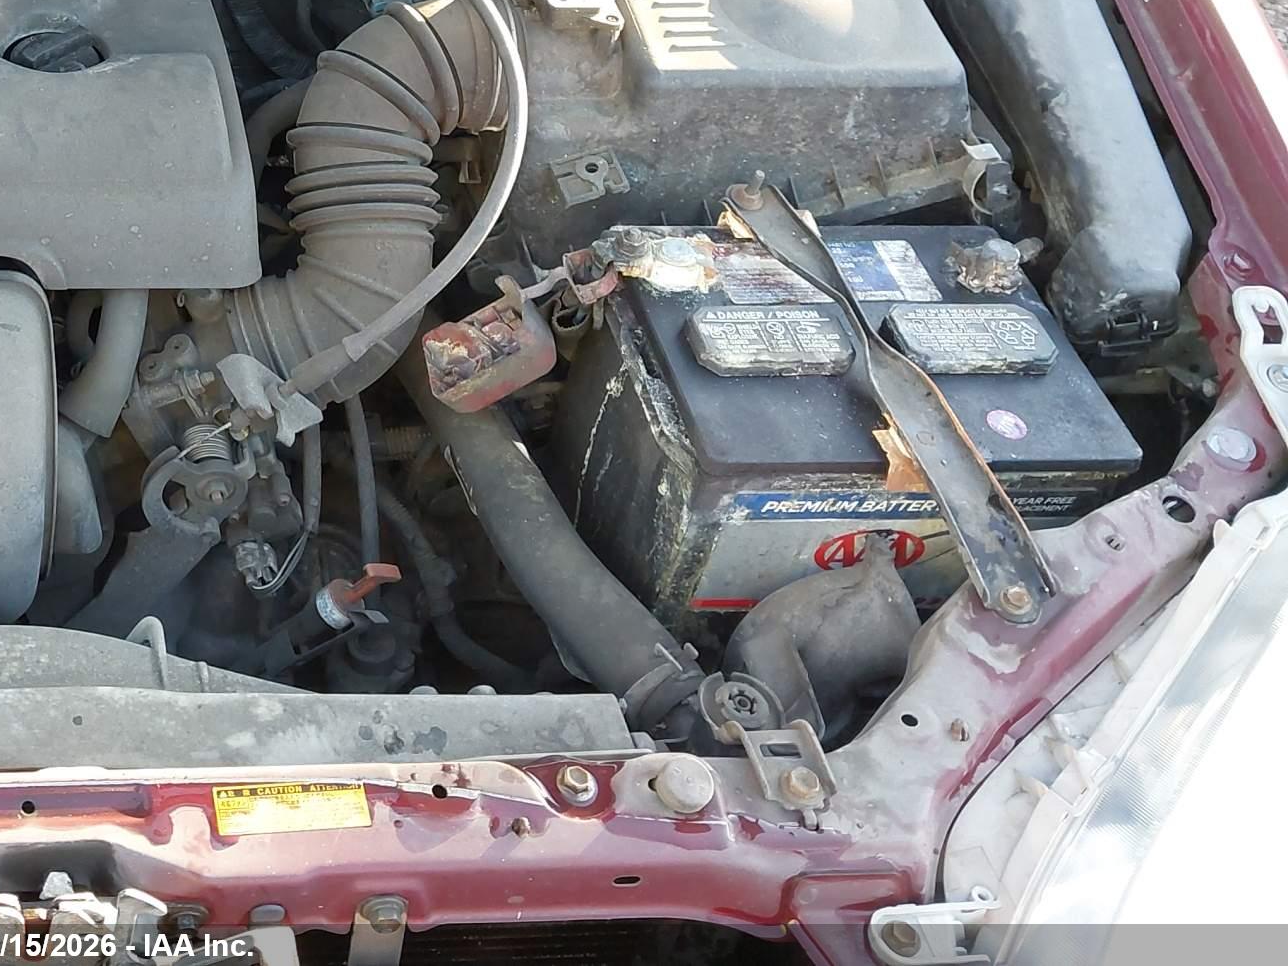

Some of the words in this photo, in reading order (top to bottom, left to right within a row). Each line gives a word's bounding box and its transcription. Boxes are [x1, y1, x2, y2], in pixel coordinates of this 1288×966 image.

[717, 310, 765, 320] DANGER
[776, 309, 820, 319] POISON
[1044, 496, 1077, 504] FREE
[761, 500, 858, 514] PREMIUM
[858, 500, 940, 513] BATTER
[257, 786, 302, 796] CAUTION
